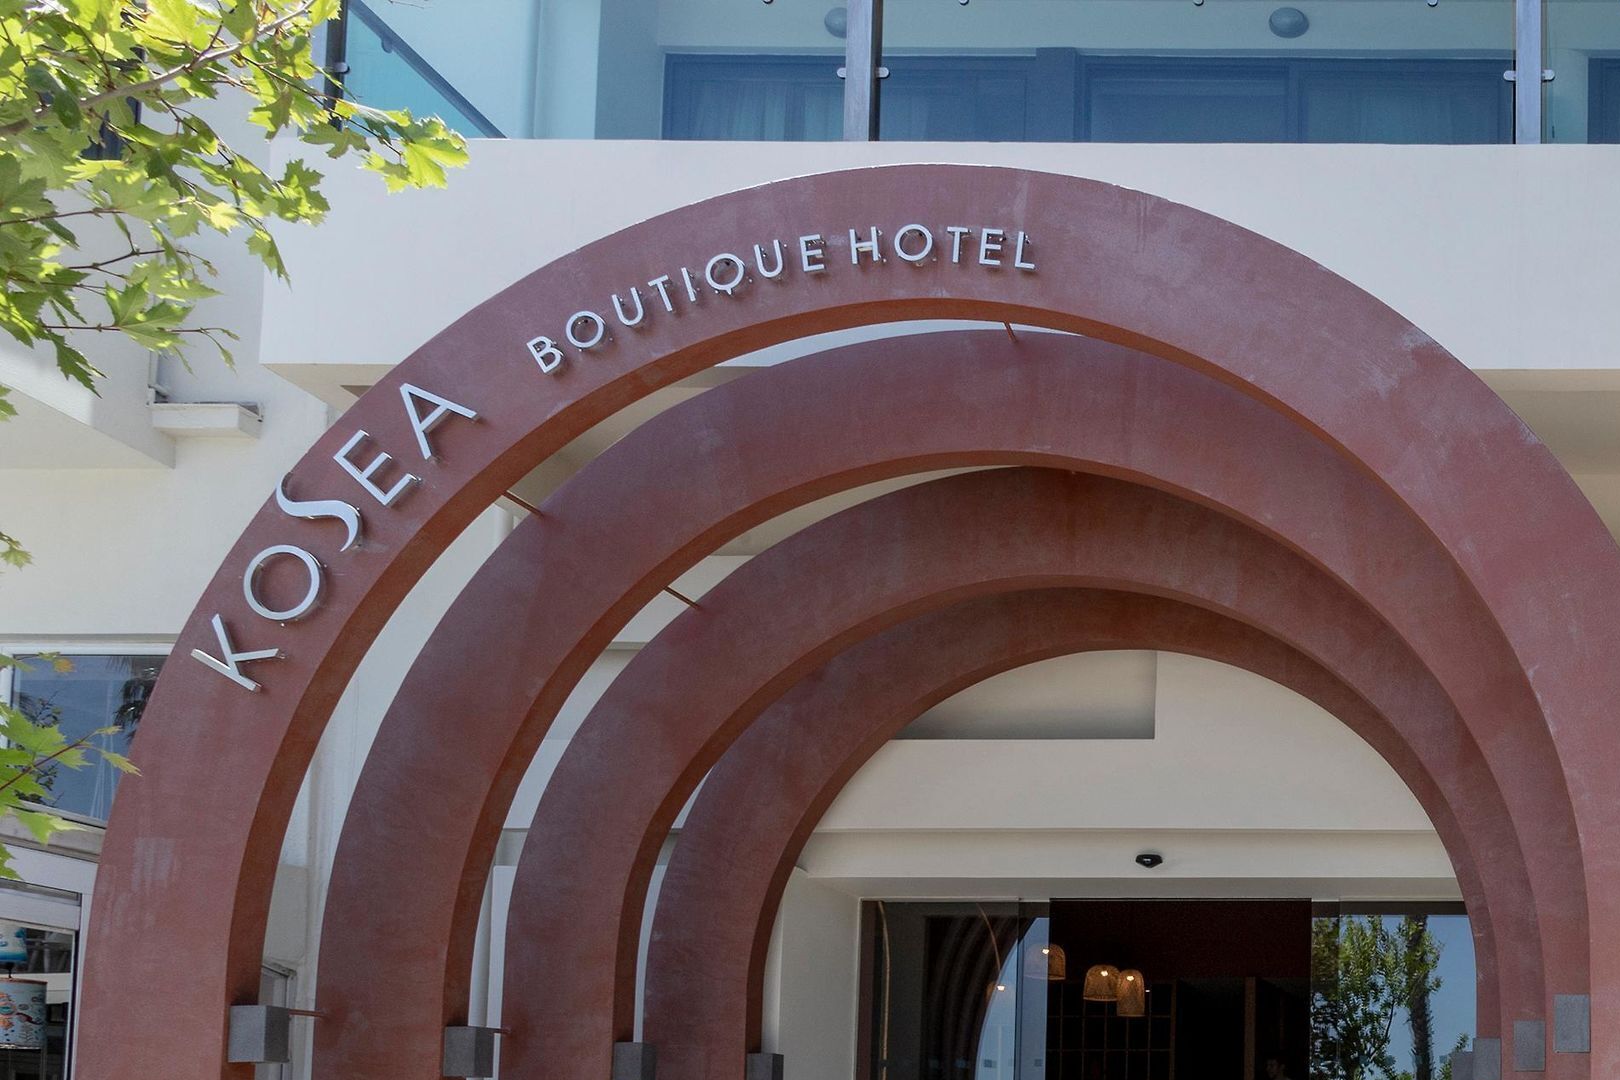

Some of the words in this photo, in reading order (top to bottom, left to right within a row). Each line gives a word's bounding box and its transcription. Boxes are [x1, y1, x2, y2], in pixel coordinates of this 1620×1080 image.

[190, 381, 478, 692] KOSEA
[526, 233, 826, 374] BOUTIQUE
[849, 223, 1037, 271] HOTEL
